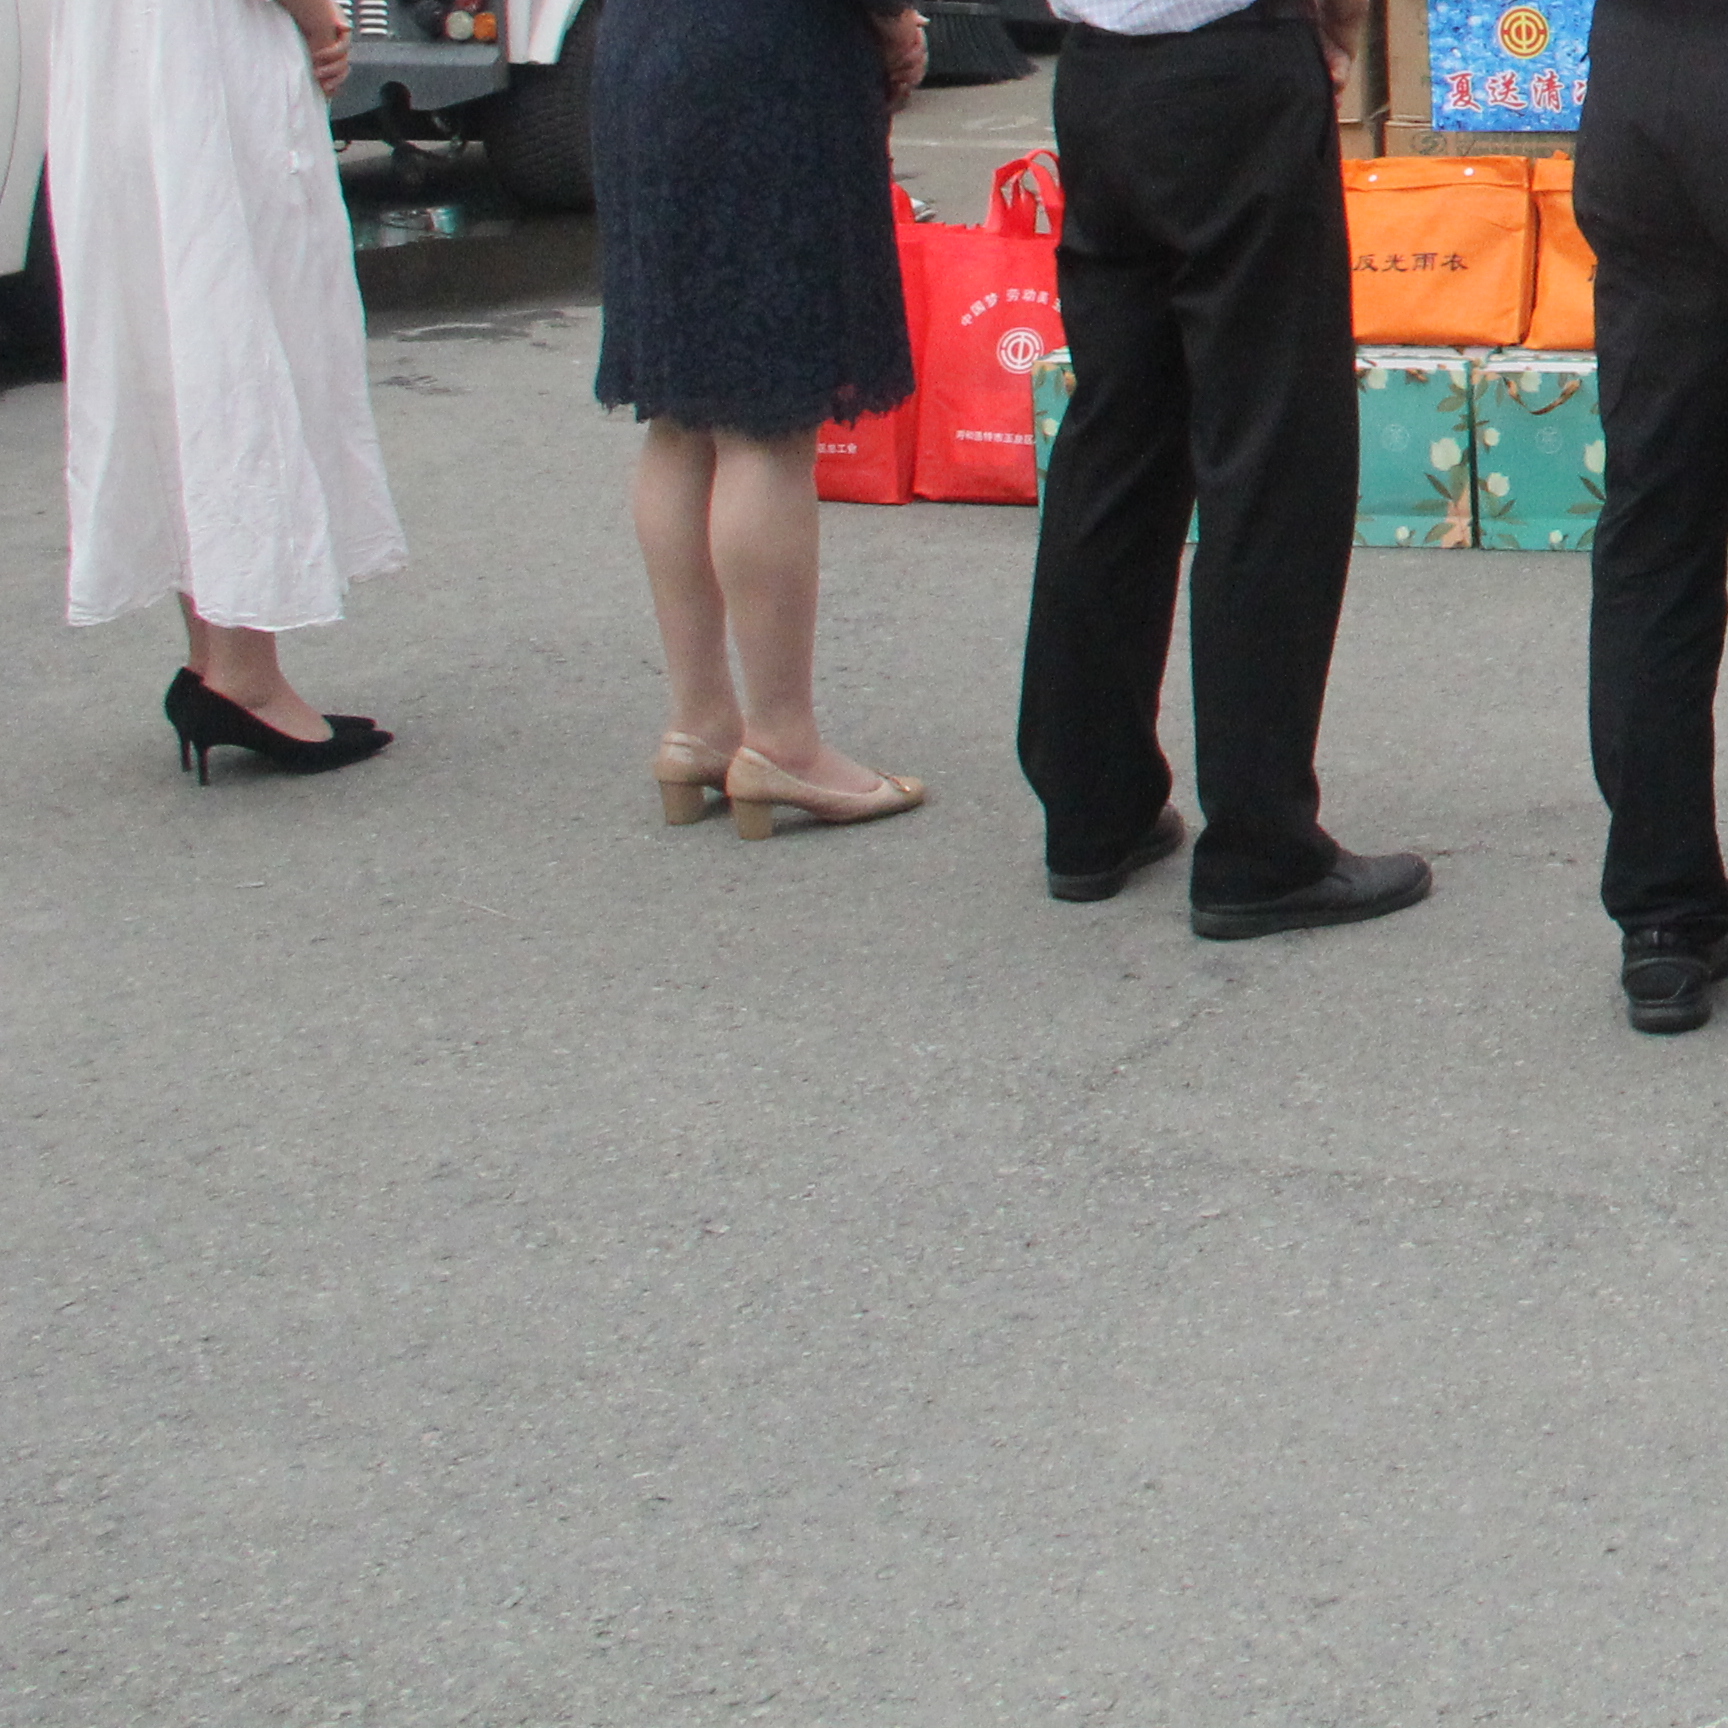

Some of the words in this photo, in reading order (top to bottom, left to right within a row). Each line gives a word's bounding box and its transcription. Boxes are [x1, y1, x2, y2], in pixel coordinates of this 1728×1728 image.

[1352, 251, 1470, 273] 反光雨衣
[955, 429, 1036, 446] 呼和浩特市玉泉区
